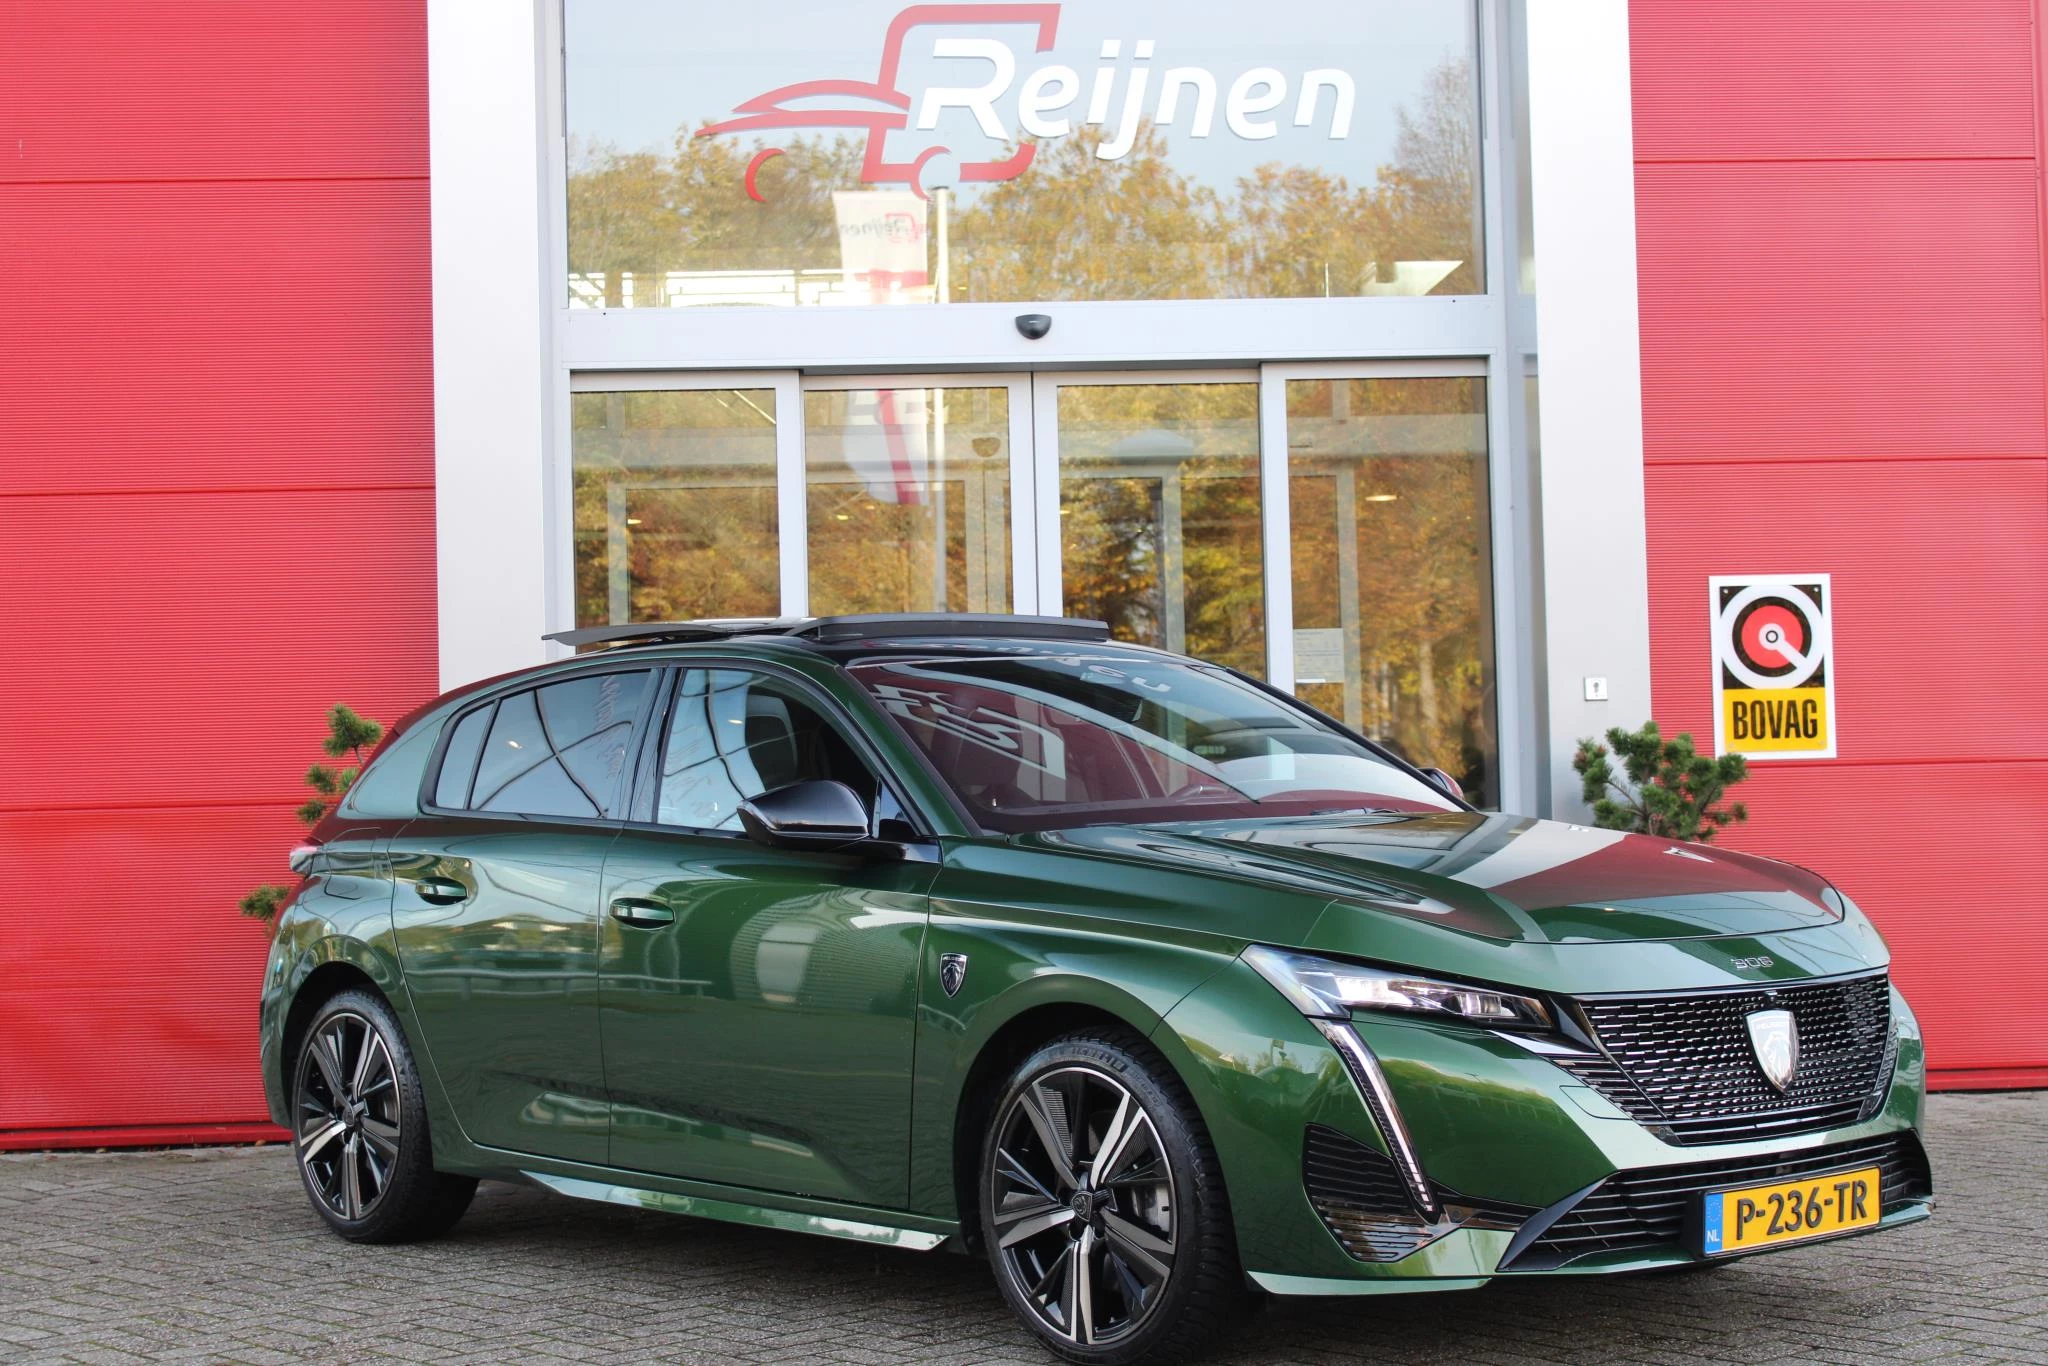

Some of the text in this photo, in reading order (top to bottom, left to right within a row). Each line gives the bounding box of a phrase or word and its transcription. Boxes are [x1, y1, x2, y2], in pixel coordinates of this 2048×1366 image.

[916, 38, 1356, 161] Reijnen
[1731, 698, 1819, 741] BOVAG
[1730, 956, 1774, 969] 308
[1736, 1179, 1868, 1241] P-236-TR
[1706, 1229, 1720, 1243] NL
